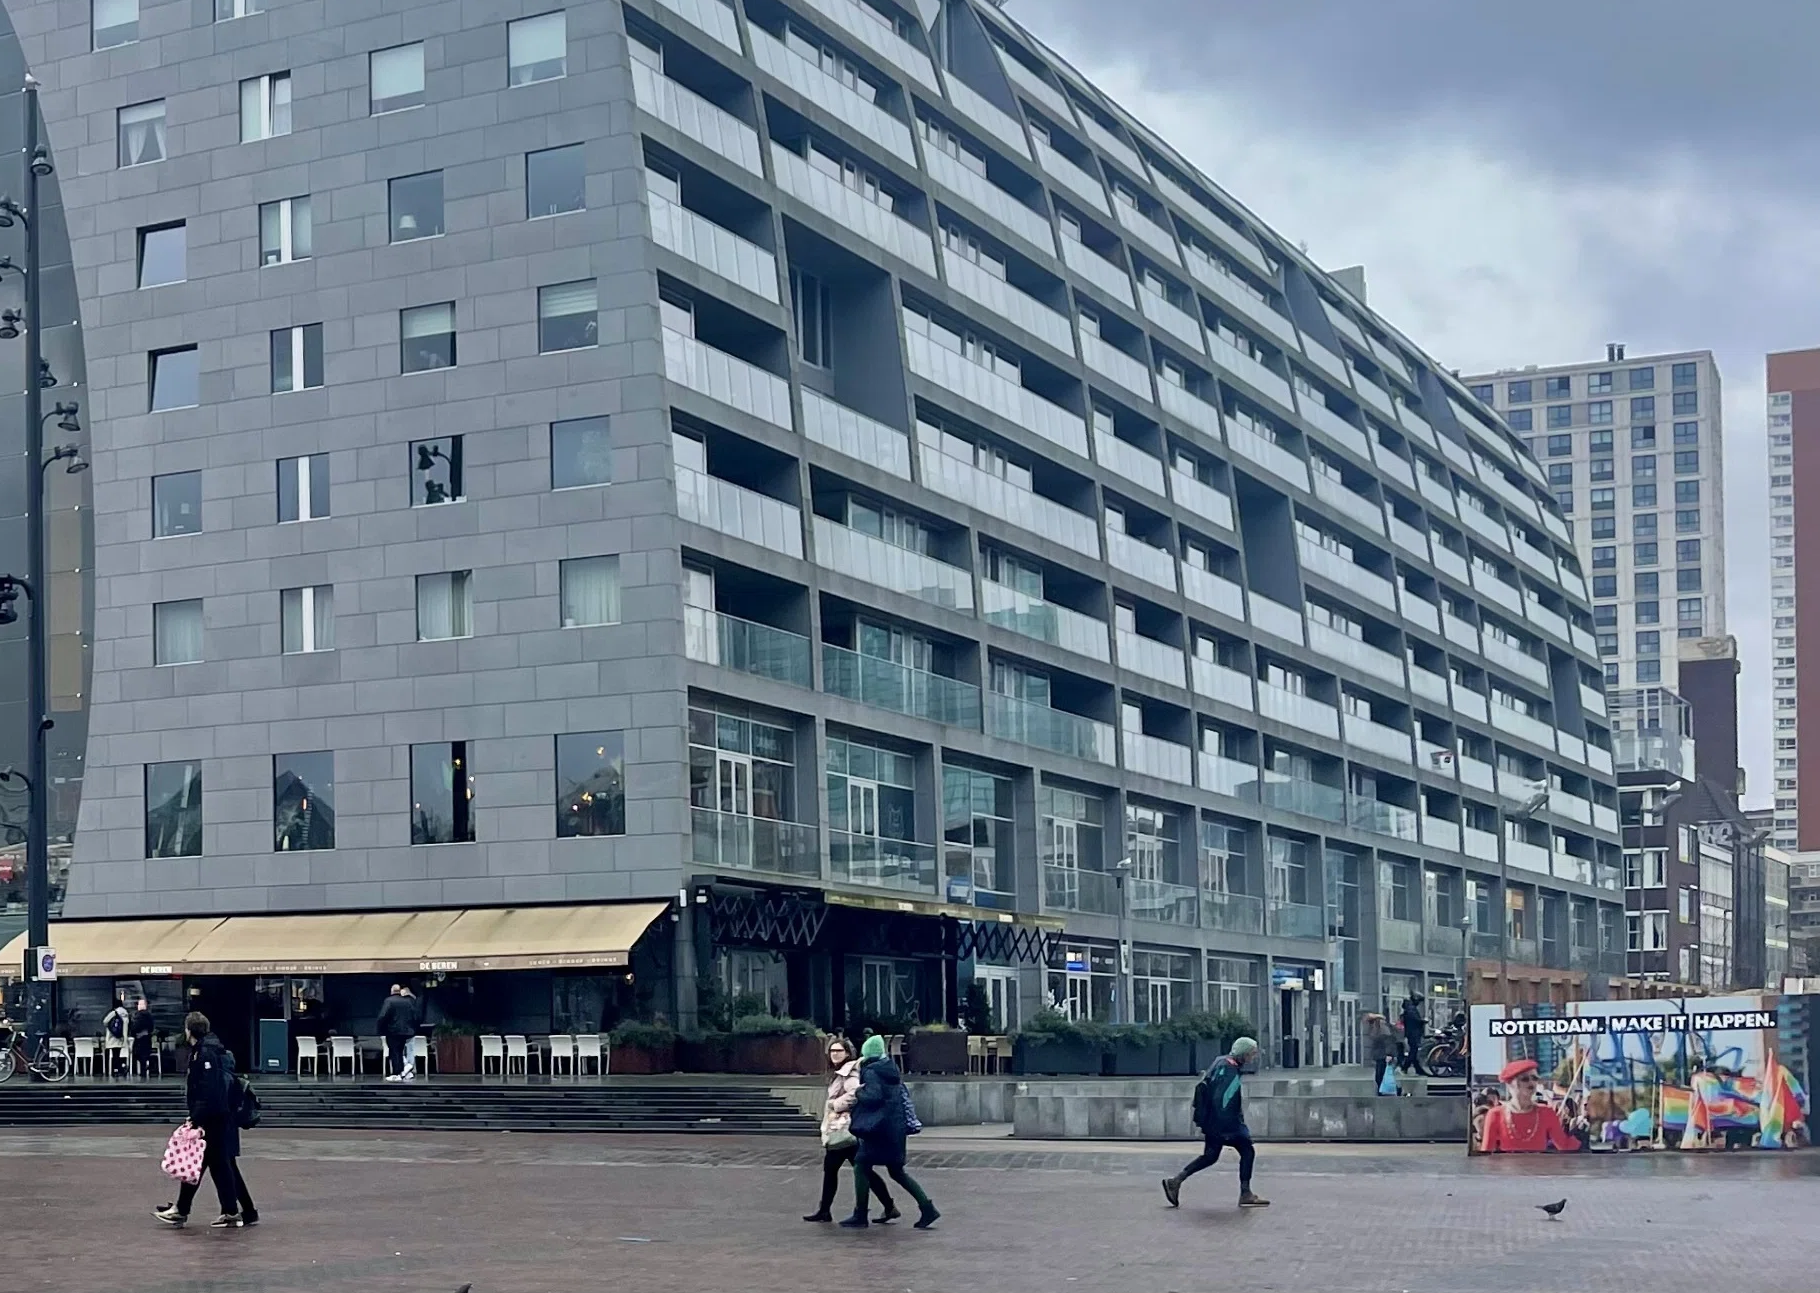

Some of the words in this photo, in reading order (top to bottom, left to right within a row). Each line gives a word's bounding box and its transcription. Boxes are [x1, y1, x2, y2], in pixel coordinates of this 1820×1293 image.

[1491, 1019, 1604, 1035] ROTTERDAM.
[1612, 1016, 1662, 1031] MAKE
[1670, 1016, 1686, 1029] IT
[1695, 1013, 1775, 1029] HAPPEN.
